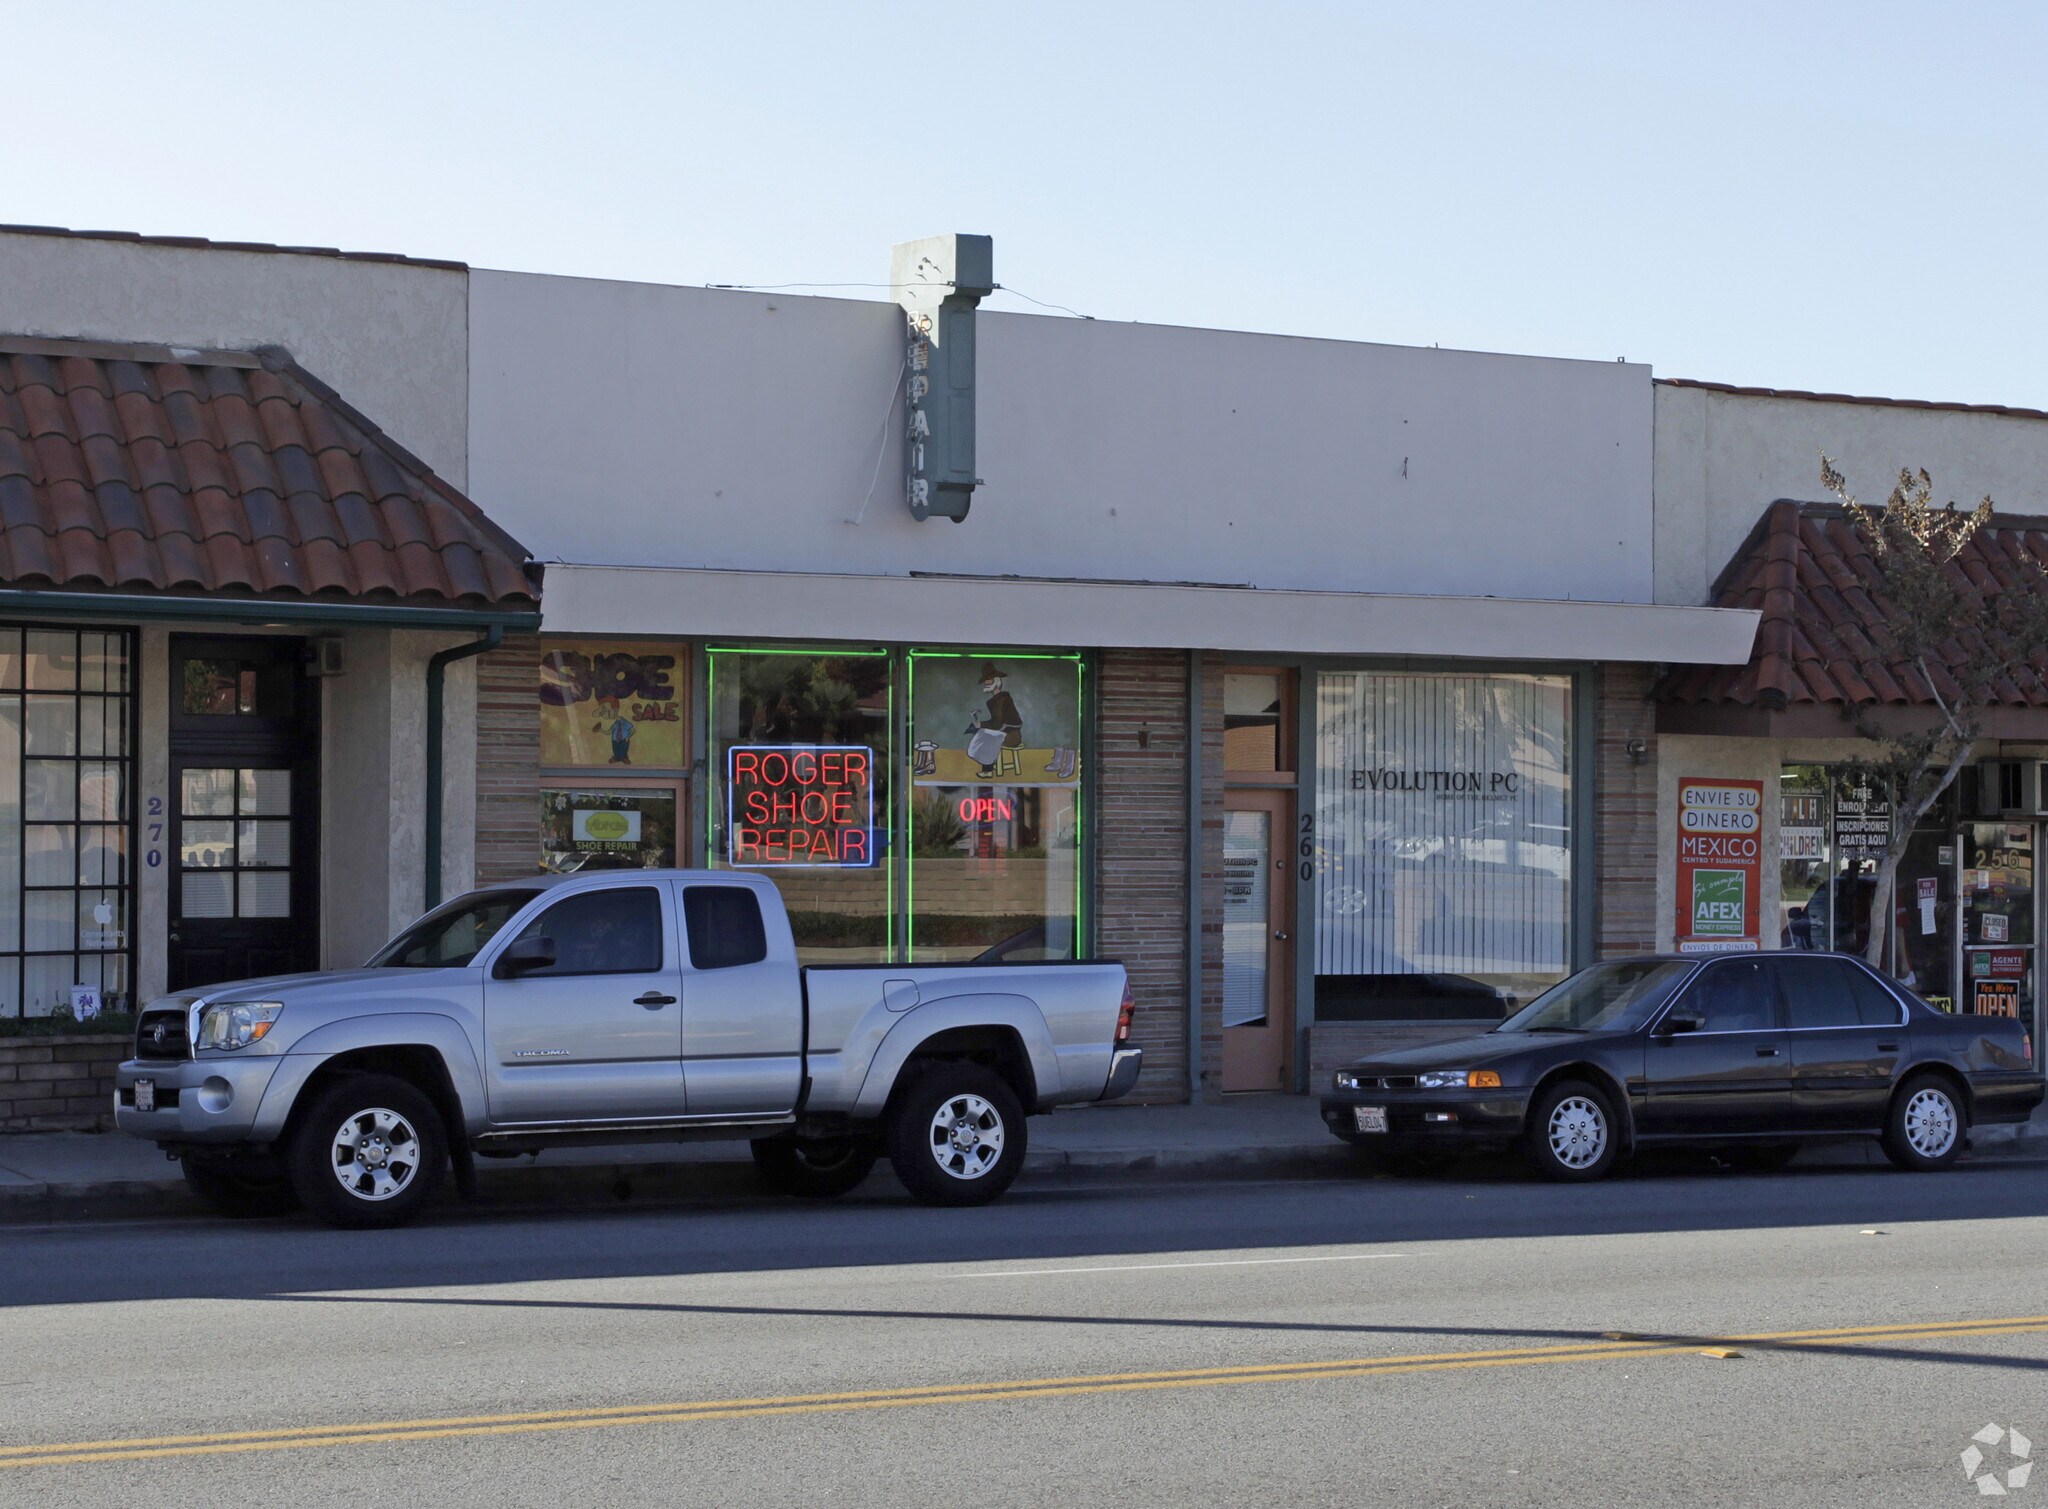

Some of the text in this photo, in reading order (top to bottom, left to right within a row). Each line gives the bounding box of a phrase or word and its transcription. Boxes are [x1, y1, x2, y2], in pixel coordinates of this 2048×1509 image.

[539, 650, 675, 706] SHOE
[632, 702, 680, 722] SALE
[736, 752, 867, 786] ROGER
[1351, 768, 1519, 793] EVOLUTION PC
[1686, 790, 1756, 807] ENVIE SU
[1852, 788, 1873, 800] FREE
[745, 791, 853, 825] SHOE
[960, 798, 1013, 823] OPEN
[1687, 811, 1754, 829] DINERO
[1836, 821, 1889, 832] INSCRIPCIONES
[146, 796, 163, 868] 270
[1839, 834, 1887, 846] GRATIS AQUI
[575, 841, 638, 851] SHOE REPAIR
[737, 829, 867, 862] REPAIR
[1300, 813, 1314, 882] 260
[1682, 836, 1757, 857] MEXICO
[1682, 856, 1709, 864] CENTRO
[1975, 848, 2020, 870] 256
[1919, 887, 1935, 898] SALE
[1696, 901, 1742, 920] AFEX
[1984, 916, 2007, 929] CLOSED
[1682, 943, 1756, 952] ENVIOS DE DINERO
[1992, 956, 2022, 964] AGENTE
[1976, 993, 2017, 1019] OPEN
[512, 1048, 570, 1057] TACOMA
